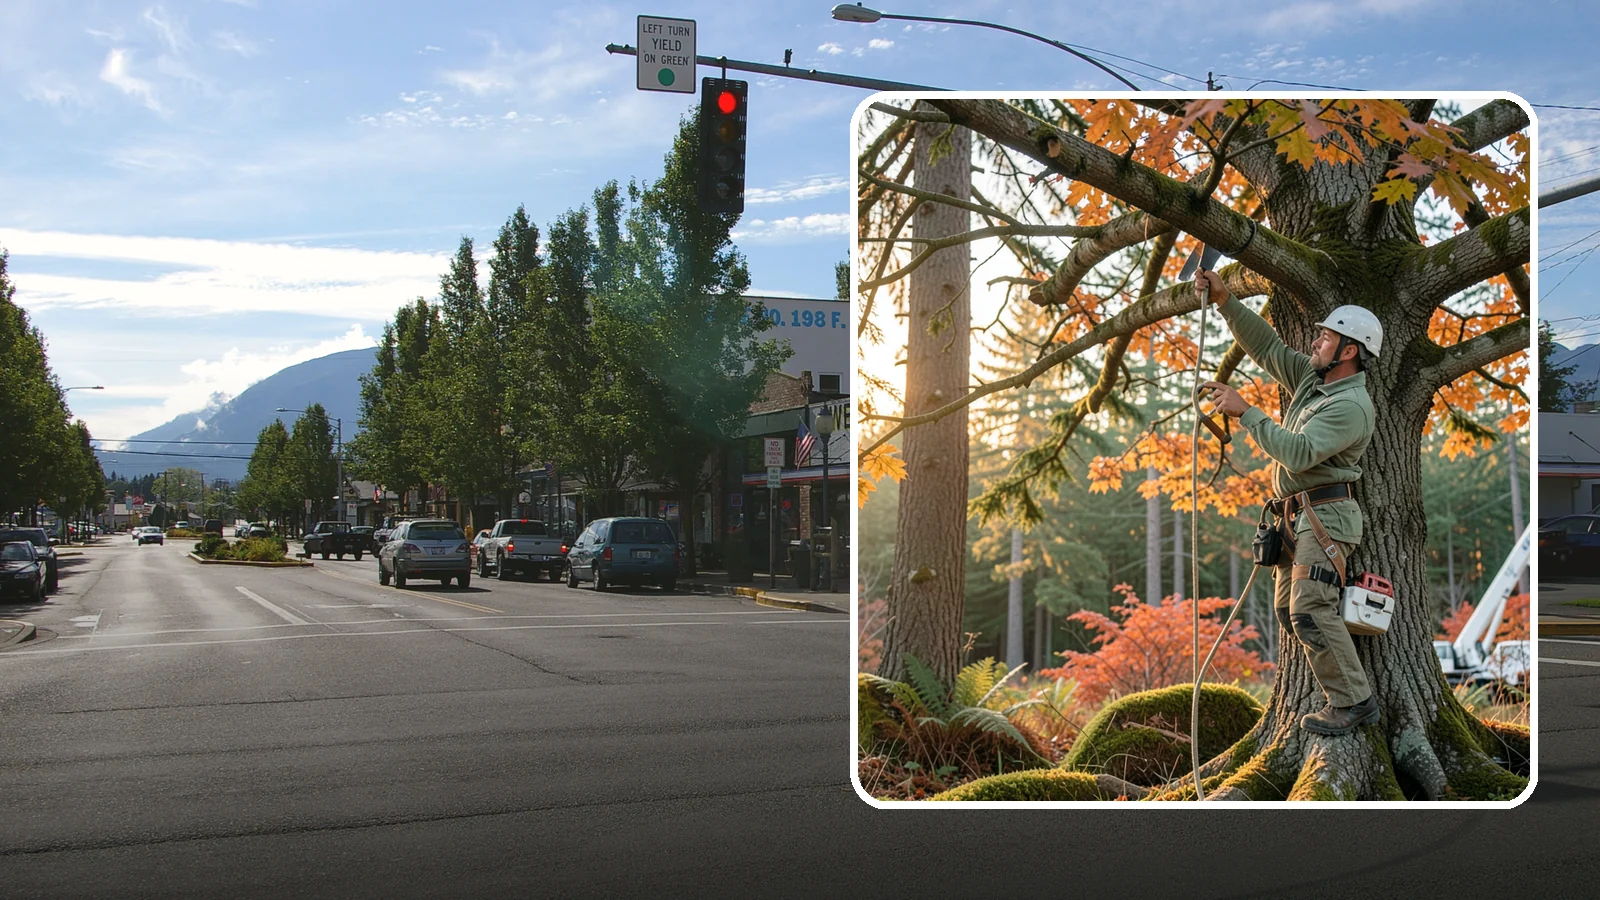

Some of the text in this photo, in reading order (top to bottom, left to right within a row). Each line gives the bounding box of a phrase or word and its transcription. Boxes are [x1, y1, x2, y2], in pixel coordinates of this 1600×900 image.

[643, 24, 690, 36] LEFT TURN
[652, 38, 682, 51] YIELD
[644, 53, 688, 66] ON GREEN
[791, 309, 826, 328] 198
[831, 311, 847, 329] F.
